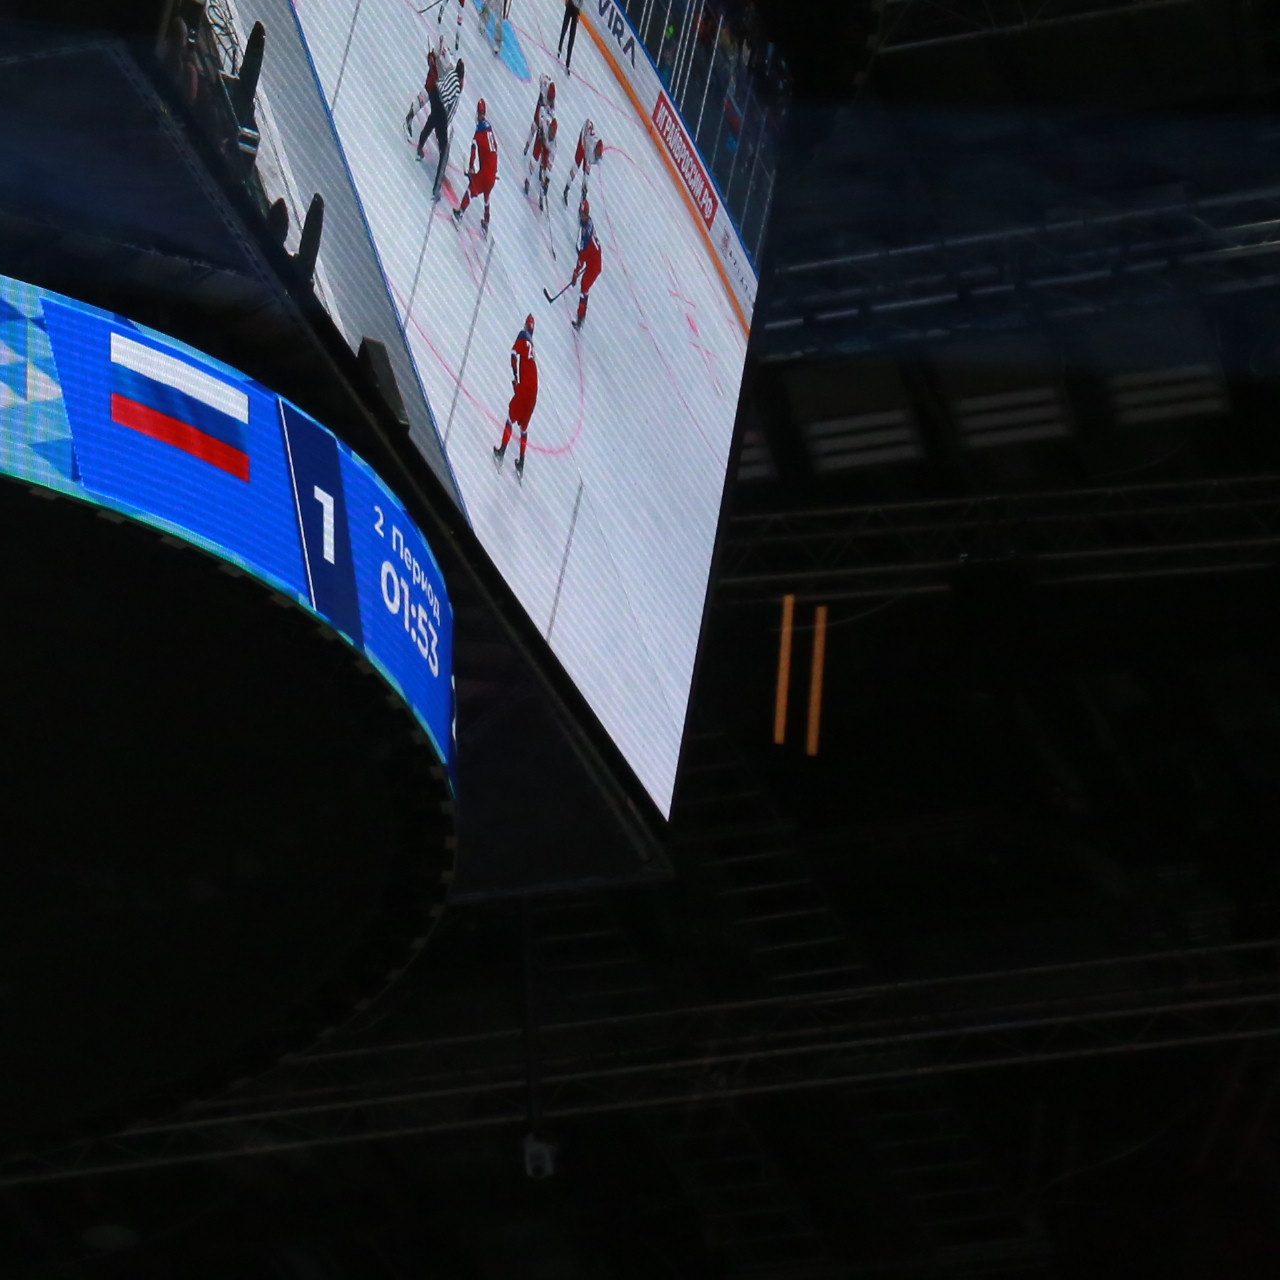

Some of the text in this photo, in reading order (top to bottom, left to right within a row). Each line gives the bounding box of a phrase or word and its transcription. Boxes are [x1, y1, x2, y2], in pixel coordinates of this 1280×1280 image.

[314, 485, 336, 566] 1
[373, 505, 441, 627] 2 Период
[380, 560, 439, 679] 01:53
